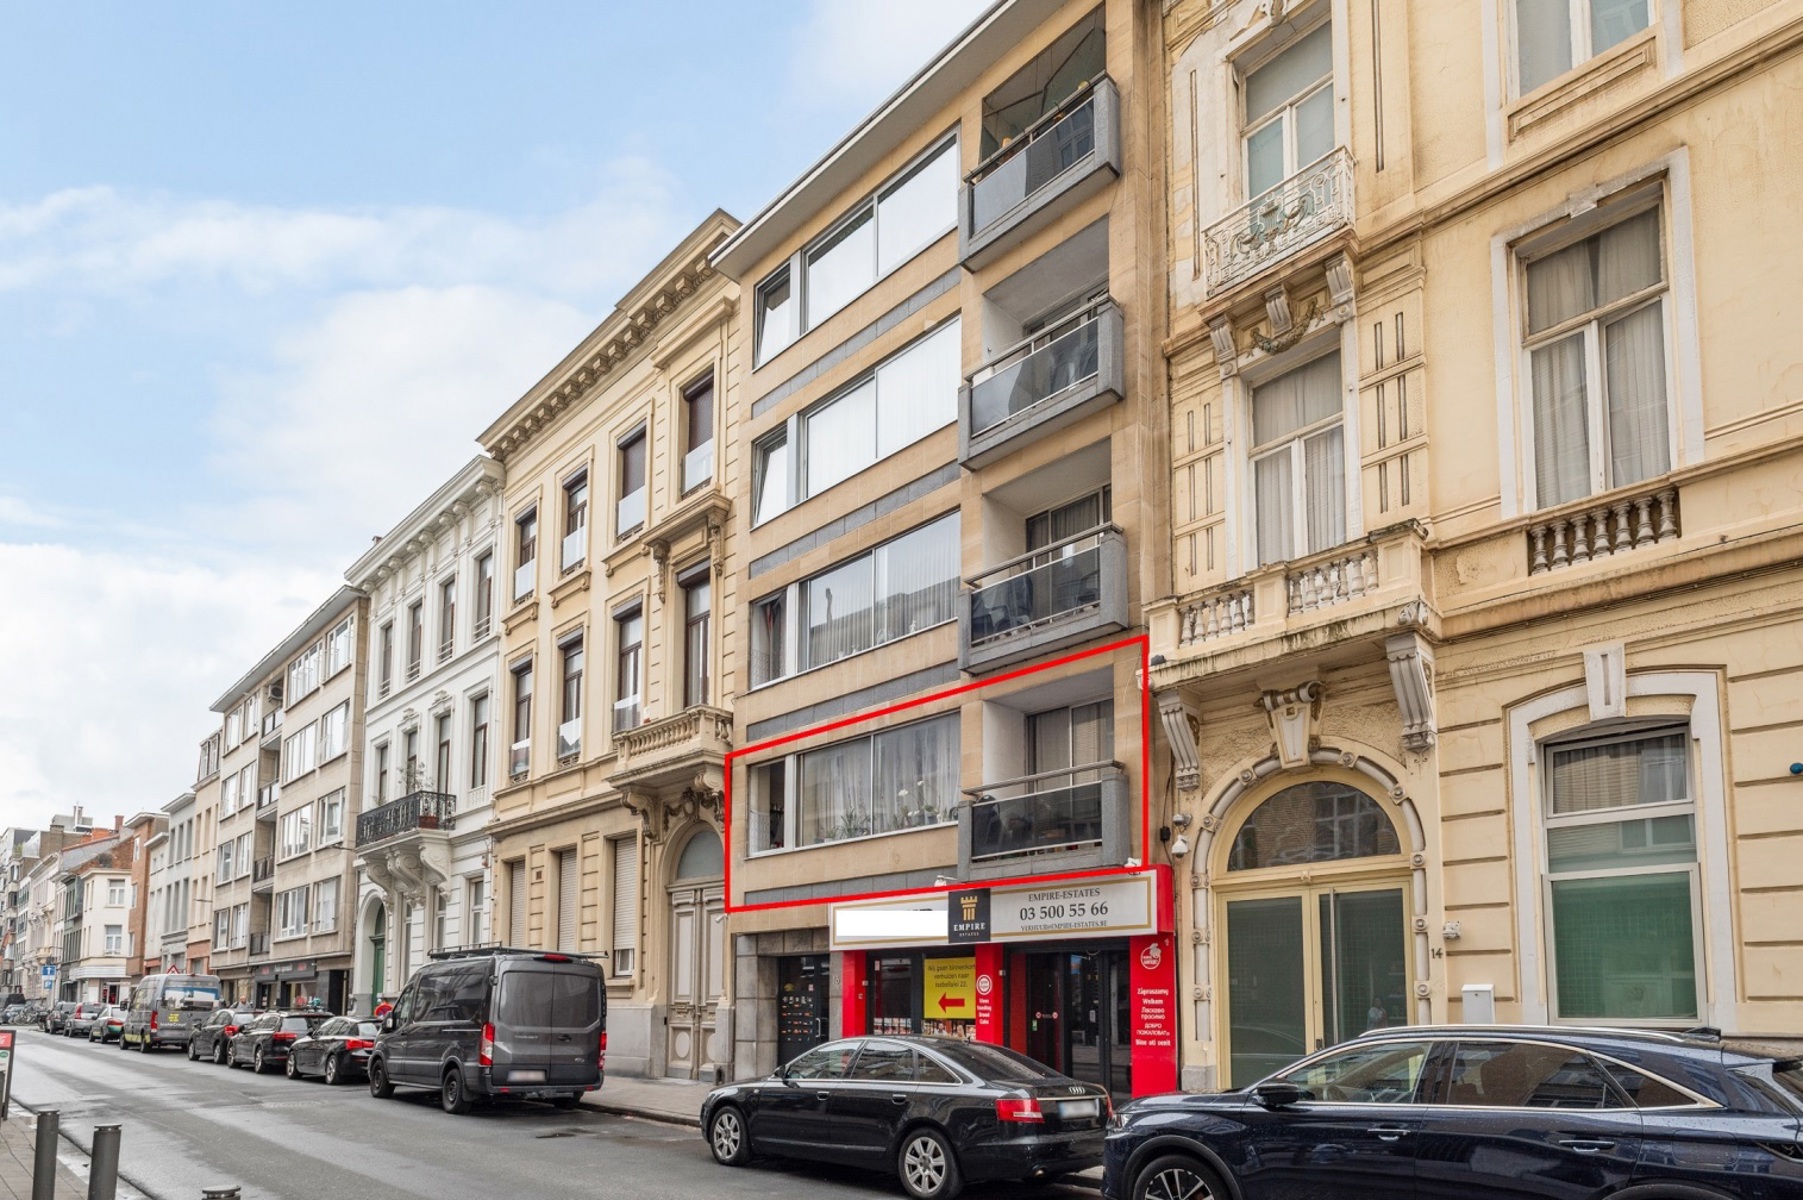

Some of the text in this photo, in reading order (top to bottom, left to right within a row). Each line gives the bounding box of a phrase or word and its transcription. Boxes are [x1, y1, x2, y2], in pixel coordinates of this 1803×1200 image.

[1028, 888, 1101, 902] EMPIRE-ESTATES
[1020, 901, 1109, 921] 03 500 55 66
[953, 921, 986, 932] EMPIRE
[1431, 947, 1443, 959] 14
